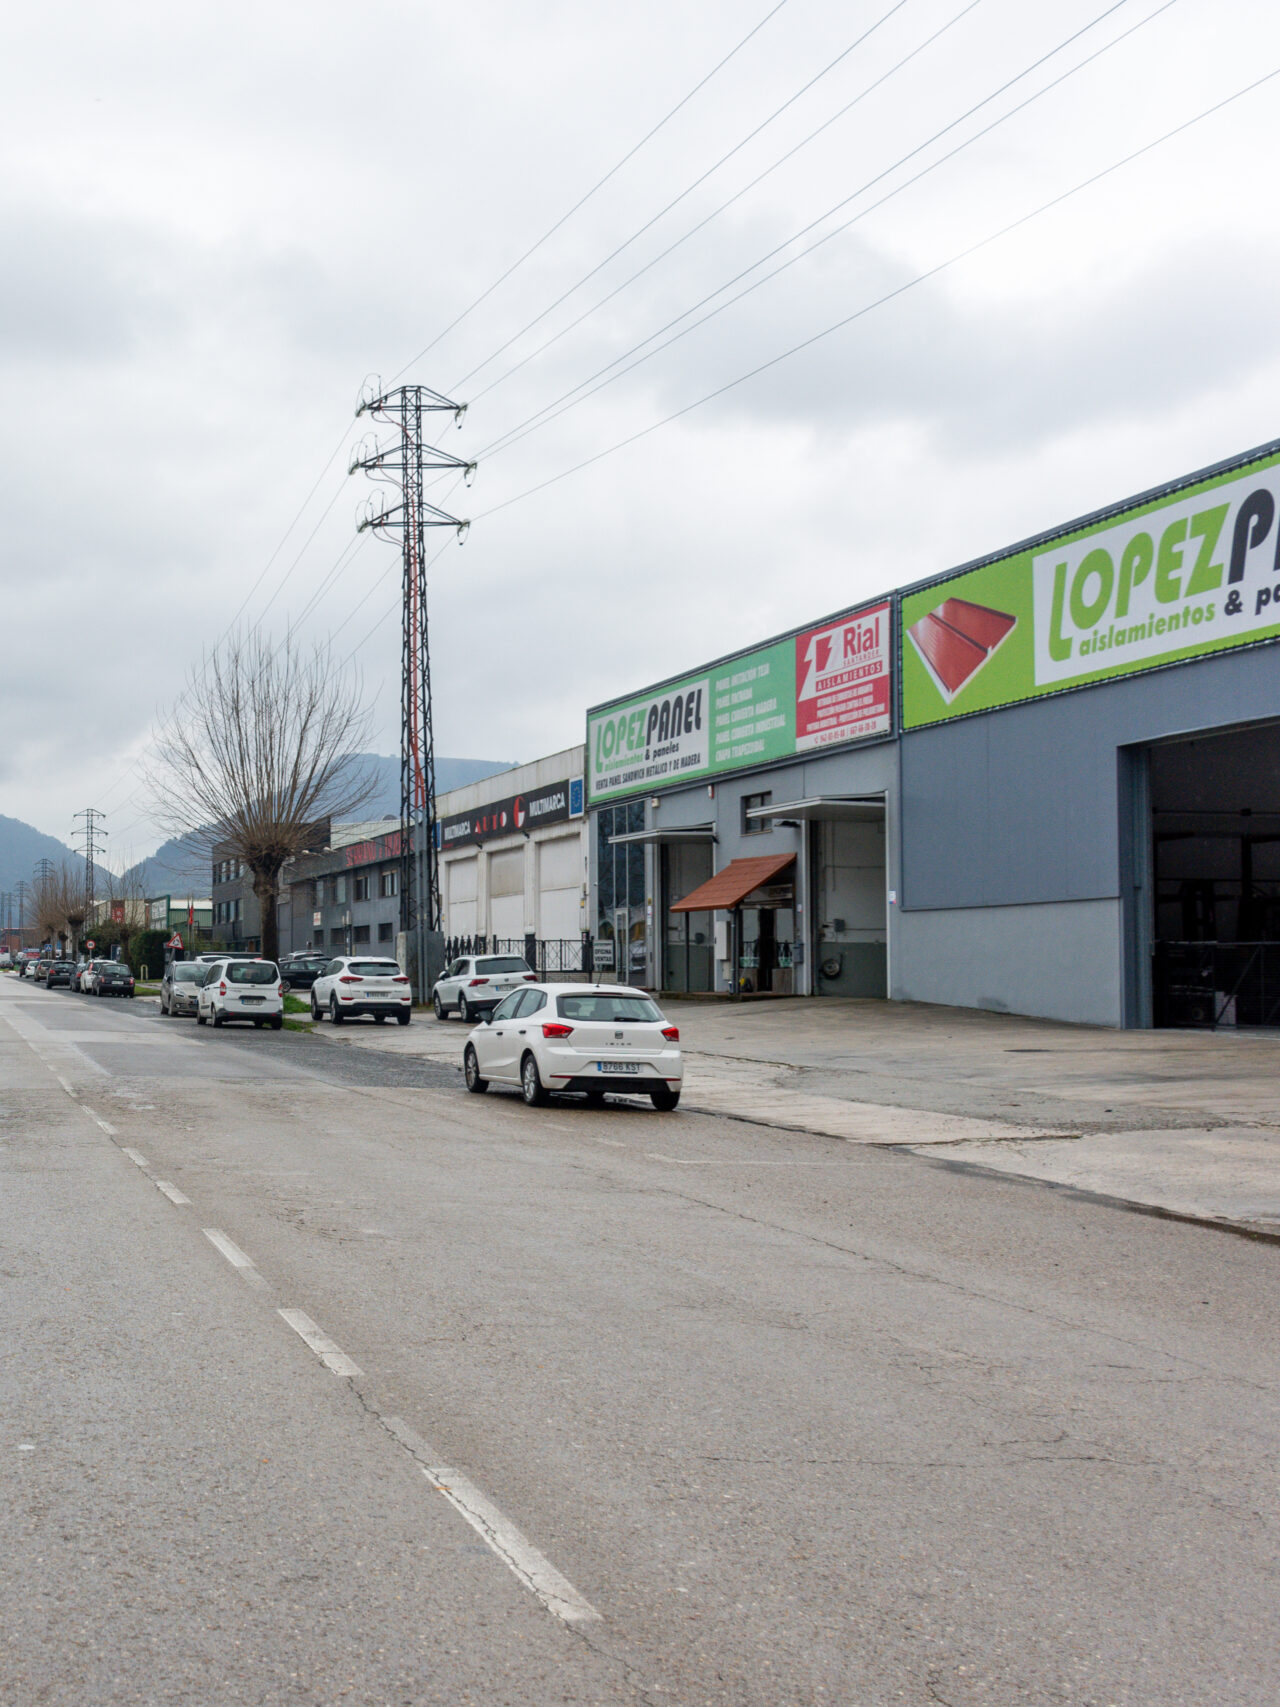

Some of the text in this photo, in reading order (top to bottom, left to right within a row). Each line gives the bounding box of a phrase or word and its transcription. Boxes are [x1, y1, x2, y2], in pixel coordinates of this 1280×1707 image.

[1049, 488, 1280, 662] LOPEZP
[843, 616, 880, 659] Rial
[1079, 603, 1216, 656] aislamientos
[1224, 589, 1243, 616] &
[817, 663, 881, 690] AISLAMIENTOS
[609, 774, 622, 787] PANEL
[622, 768, 645, 784] SANDWICH
[673, 758, 680, 770] DE
[680, 753, 701, 768] MADERA
[645, 749, 650, 761] &
[652, 741, 680, 762] paneles
[444, 820, 471, 841] MULTIMARCA
[474, 811, 507, 834] AUTO
[529, 792, 566, 817] MULTIMARCA
